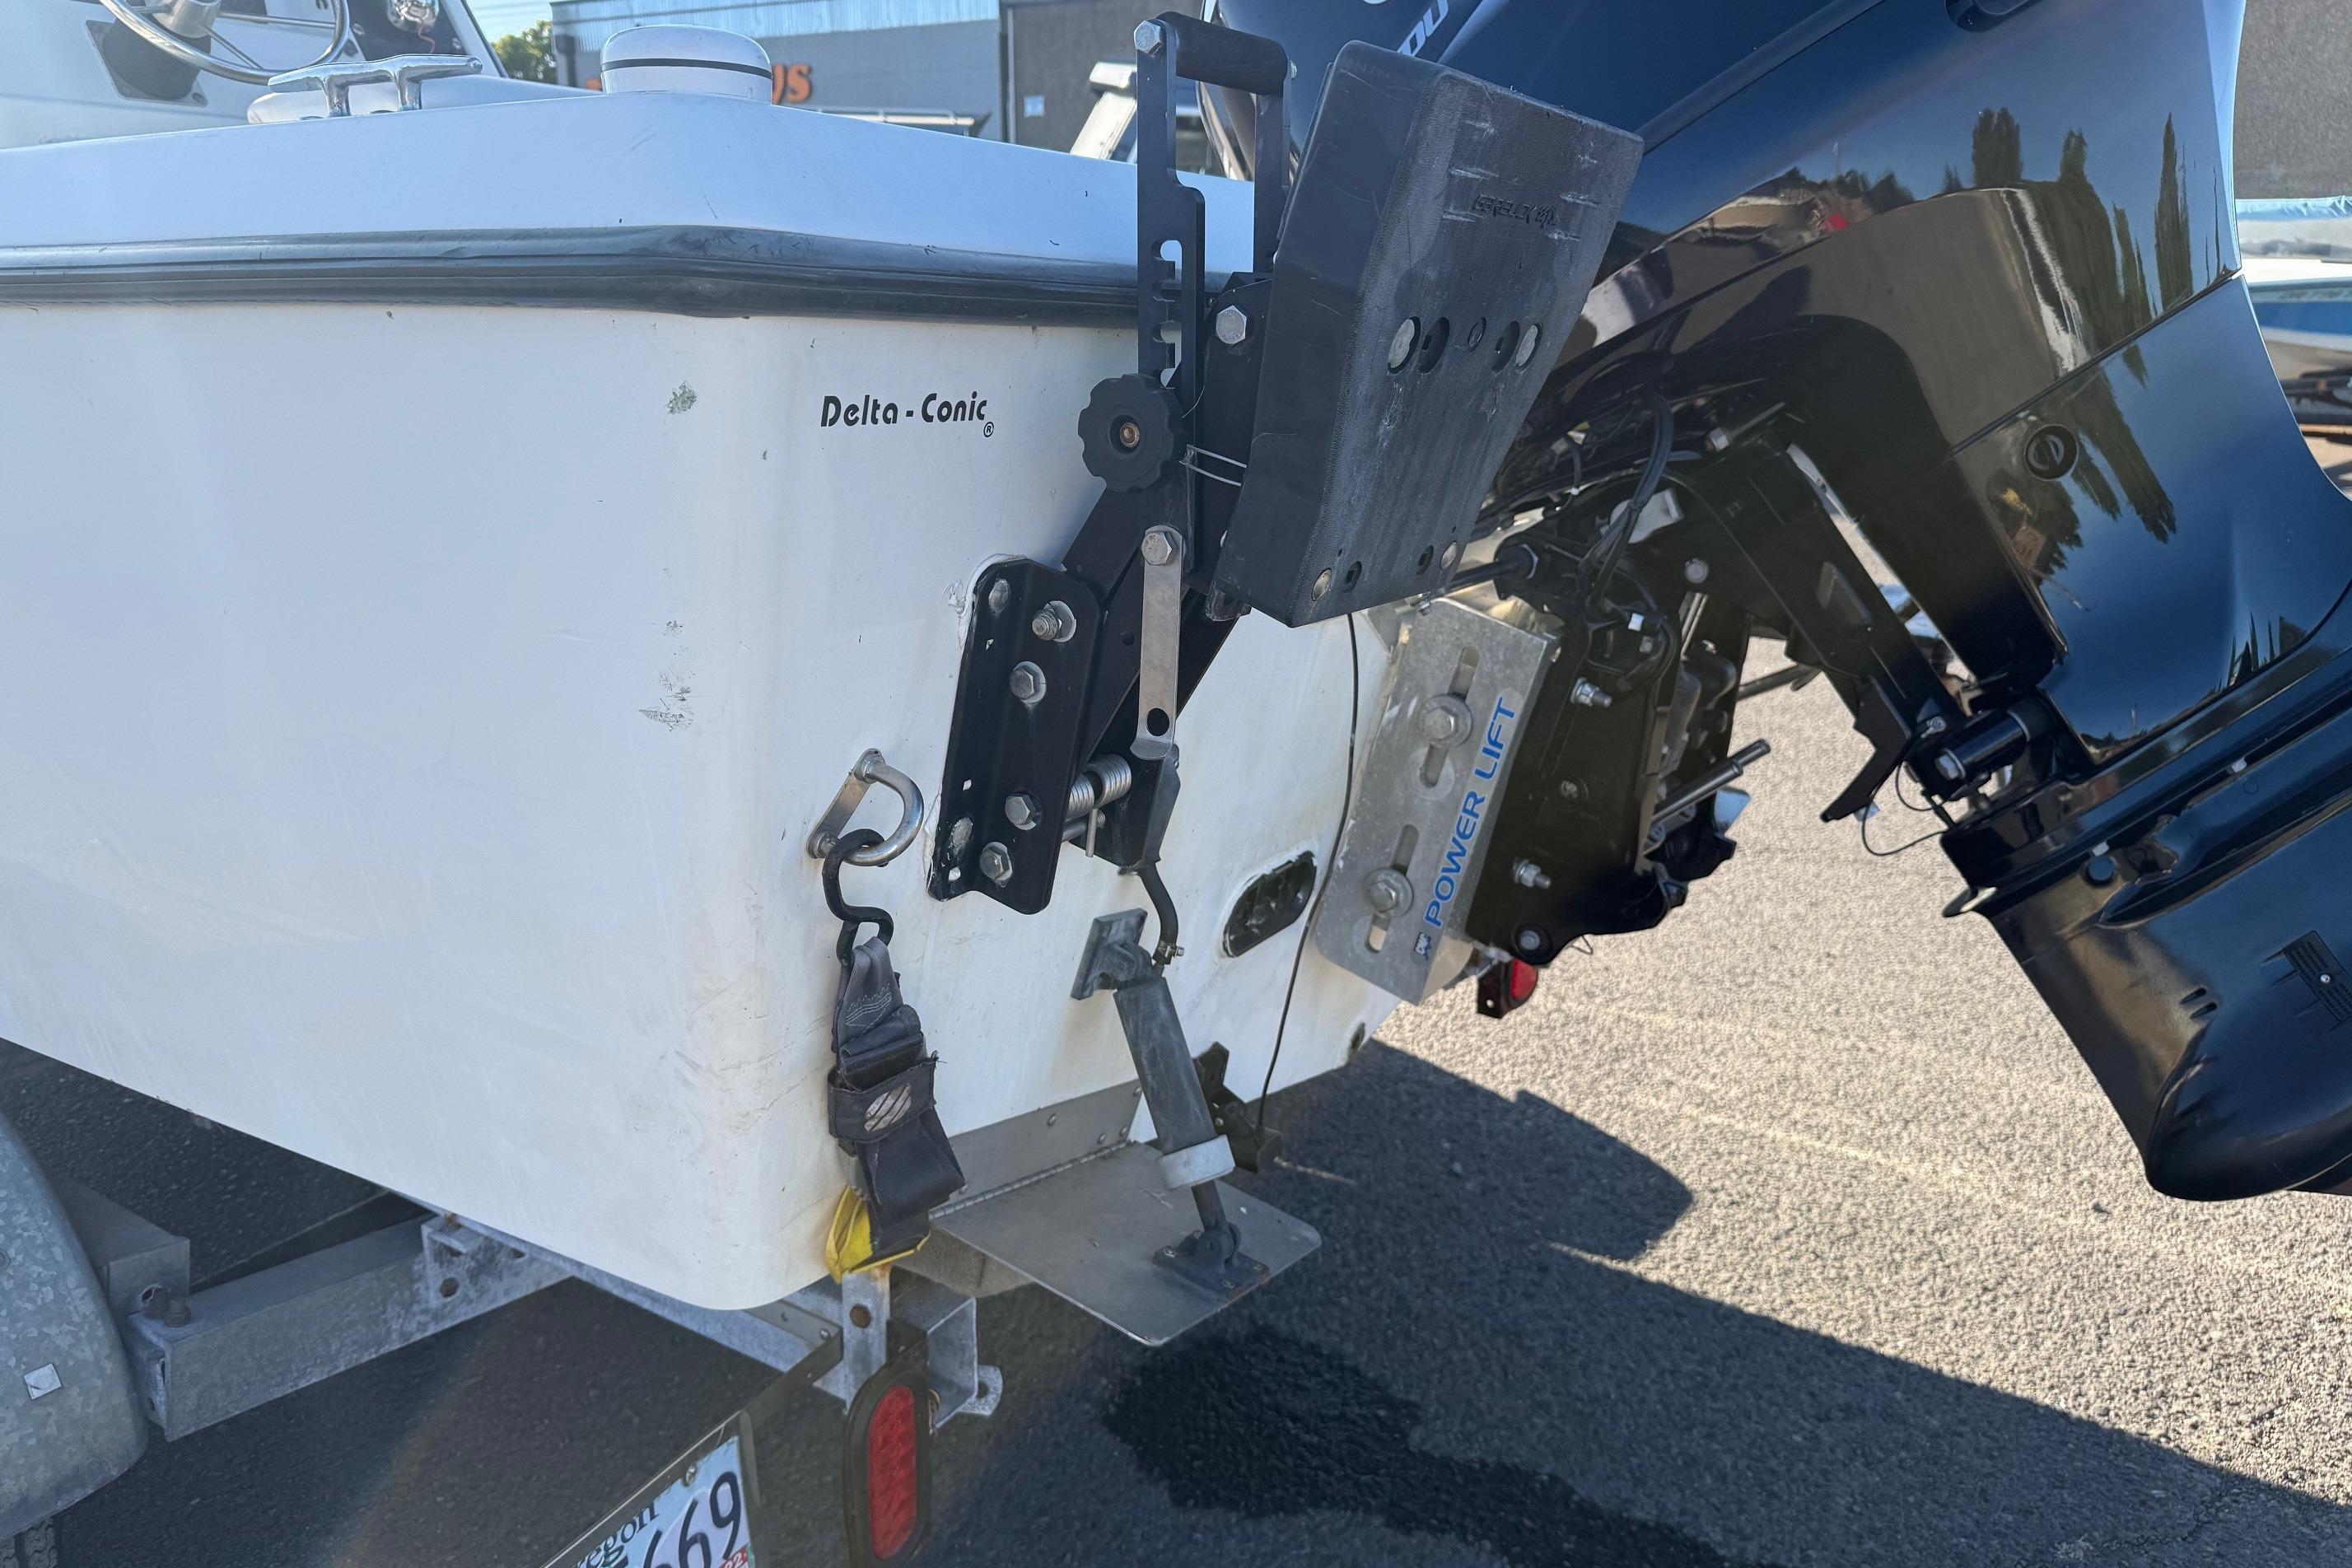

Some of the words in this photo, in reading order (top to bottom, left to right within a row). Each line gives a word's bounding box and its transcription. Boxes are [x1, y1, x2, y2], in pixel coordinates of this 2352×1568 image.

[820, 394, 898, 427] Delta
[1424, 791, 1486, 927] POWER
[1474, 697, 1515, 780] LIFT
